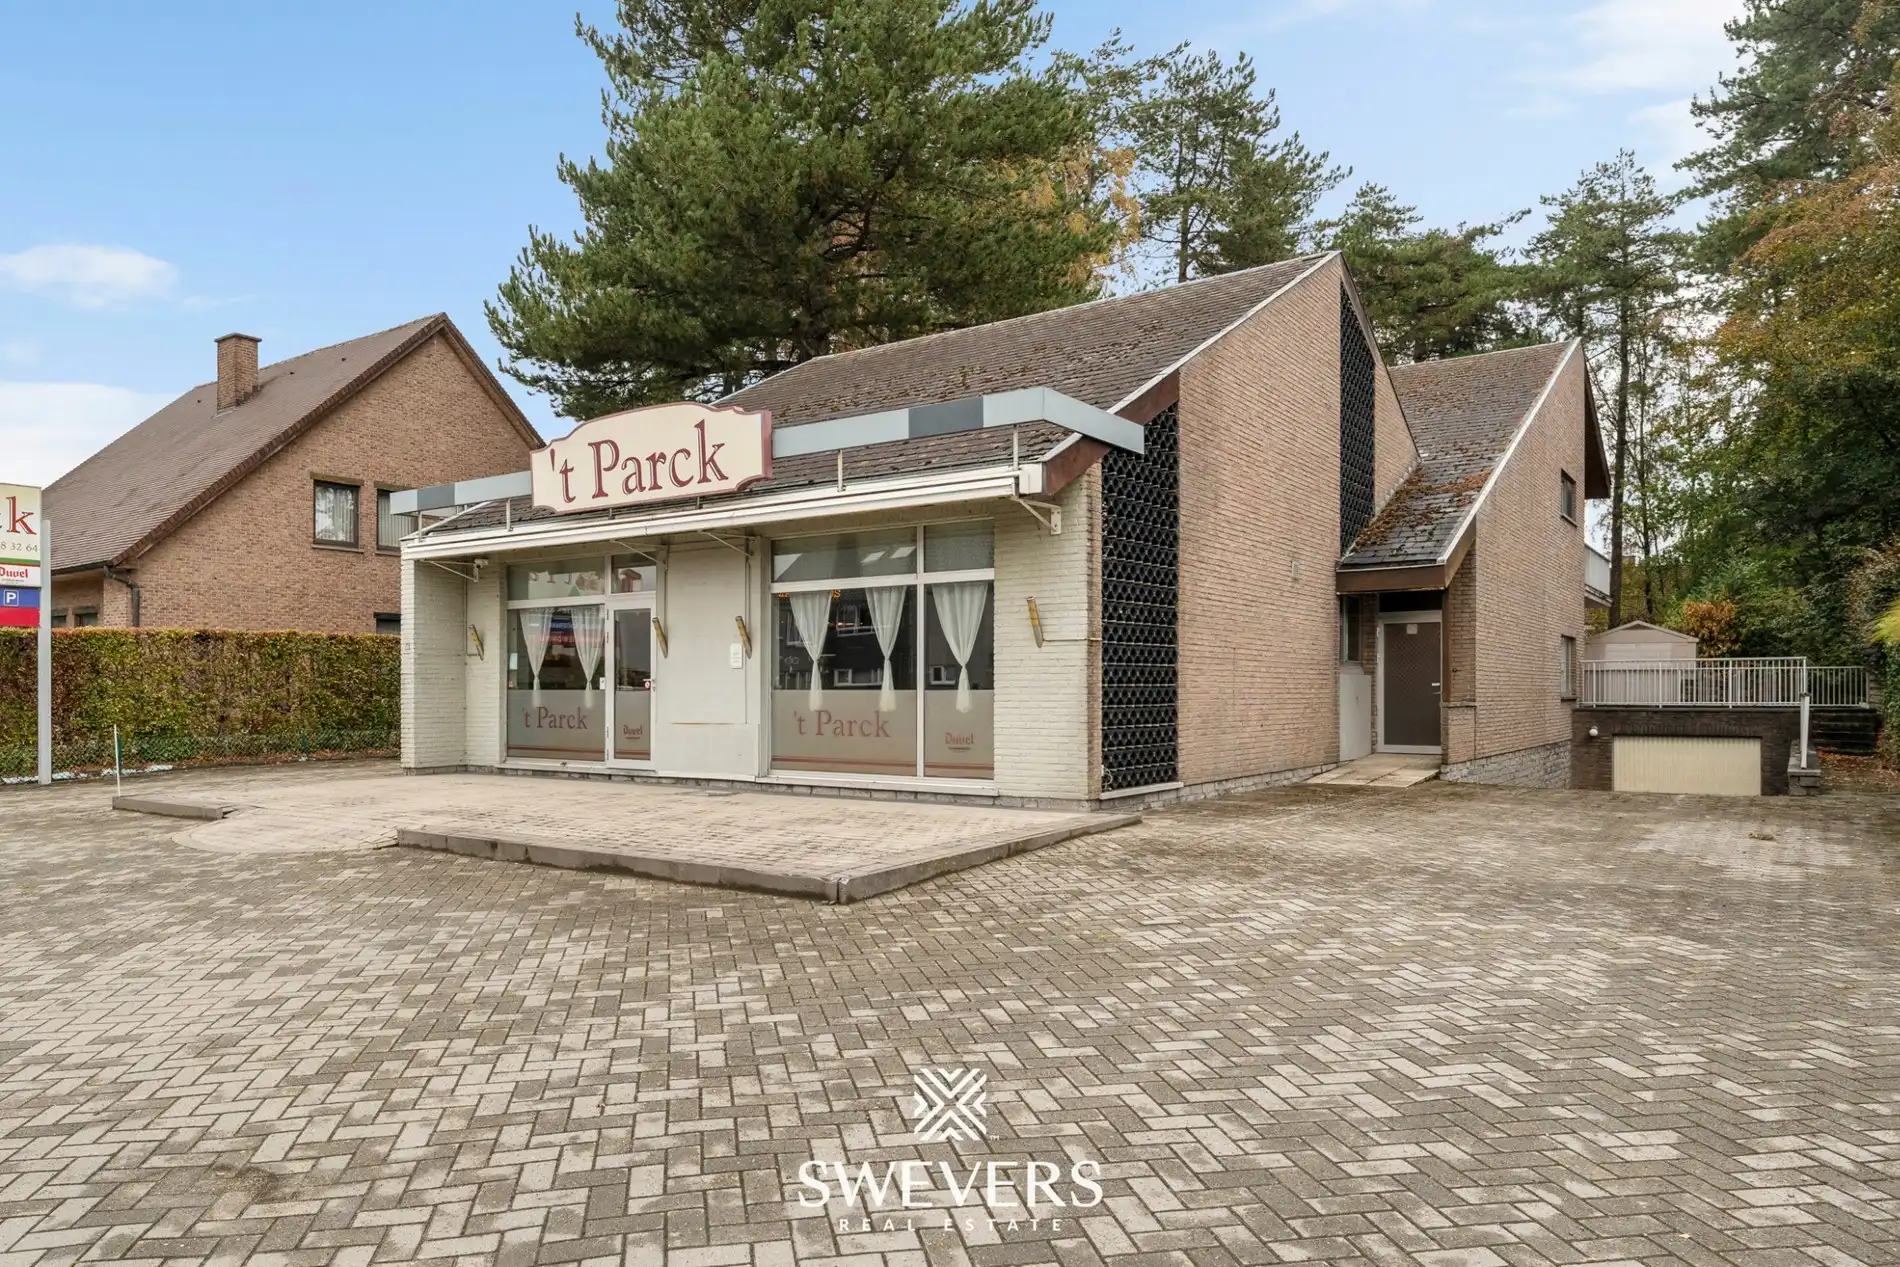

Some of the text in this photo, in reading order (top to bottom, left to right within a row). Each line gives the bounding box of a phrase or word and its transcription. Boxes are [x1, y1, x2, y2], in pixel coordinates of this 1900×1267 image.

[550, 419, 729, 504] 't Parck
[0, 496, 37, 535] k
[11, 542, 22, 551] 32
[26, 544, 38, 552] 64
[0, 566, 29, 579] Duvel
[6, 591, 17, 604] P
[535, 706, 589, 730] Parck
[793, 709, 891, 738] 't Parck
